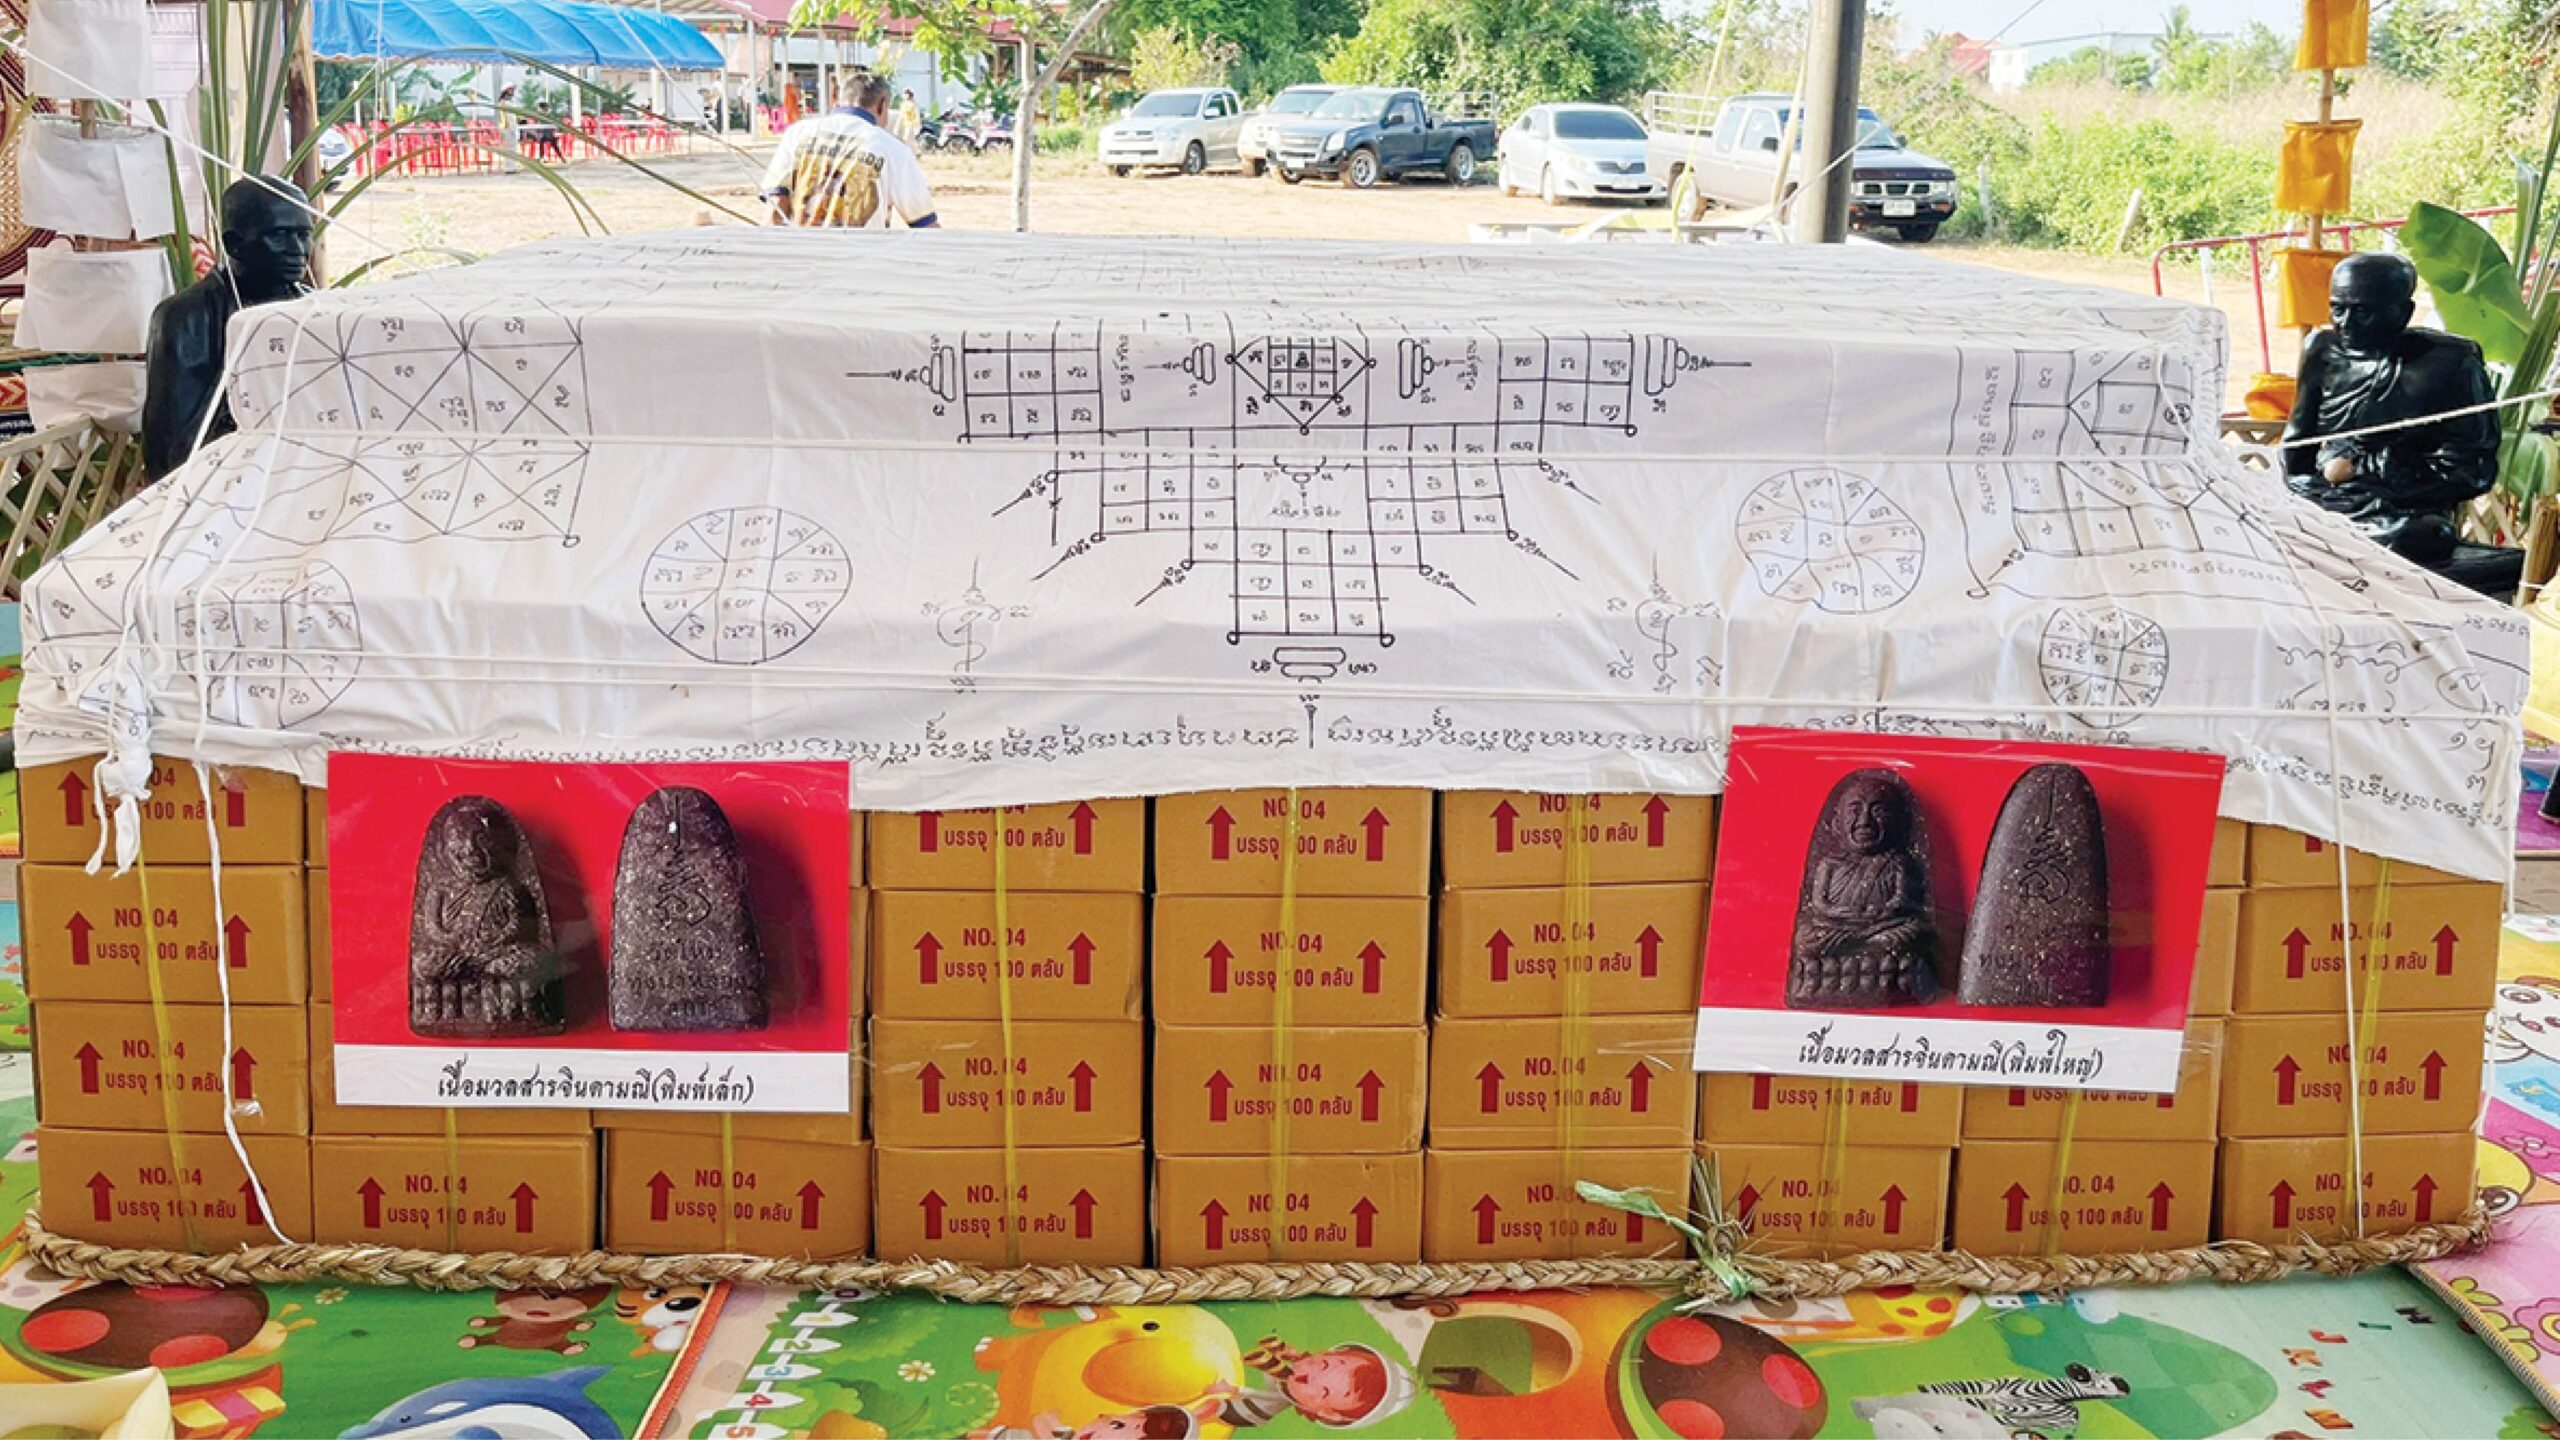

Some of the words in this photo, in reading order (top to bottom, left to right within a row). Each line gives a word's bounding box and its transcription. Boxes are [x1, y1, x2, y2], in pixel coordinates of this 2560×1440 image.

[145, 803, 175, 820] 100
[1301, 800, 1326, 819] 04
[945, 830, 988, 852] บรรจุ
[996, 829, 1025, 847] 00
[1237, 837, 1280, 860] บรรจุ
[1298, 838, 1317, 855] 00
[1521, 829, 1563, 849] บรรจุ
[154, 909, 178, 927] 04
[963, 929, 997, 947] NO.
[1298, 933, 1323, 952] 04
[1535, 923, 1566, 943] NO.
[159, 942, 178, 960] 00
[945, 961, 987, 983] บรรจุ
[1516, 956, 1557, 979] บรรจุ
[1564, 955, 1593, 972] 100
[1235, 968, 1277, 992] บรรจุ
[1285, 968, 1314, 986] 00
[123, 1040, 155, 1059] NO.
[965, 1058, 999, 1076] NO.
[1298, 1063, 1323, 1082] 04
[1525, 1058, 1556, 1076] NO.
[106, 1072, 147, 1096] บรรจุ
[2301, 1081, 2343, 1105] บรรจุ
[947, 1091, 989, 1112] บรรจุ
[1506, 1091, 1547, 1112] บรรจุ
[1778, 1089, 1818, 1111] บรรจุ
[140, 1167, 173, 1185] NO.
[406, 1175, 439, 1193] NO.
[734, 1171, 757, 1190] 04
[2092, 1176, 2115, 1193] 04
[2363, 1172, 2374, 1190] 4
[967, 1185, 1001, 1204] NO.
[1782, 1180, 1813, 1197] NO.
[118, 1199, 160, 1222] บรรจุ
[675, 1199, 718, 1225] บรรจุ
[734, 1203, 754, 1221] 00
[1287, 1193, 1310, 1212] 04
[388, 1207, 429, 1230] บรรจุ
[1762, 1211, 1802, 1233] บรรจุ
[2077, 1208, 2105, 1225] 100
[2296, 1206, 2336, 1226] บรรจุ
[949, 1218, 991, 1239] บรรจุ
[1230, 1225, 1271, 1246] บรรจุ
[1501, 1221, 1543, 1243] บรรจุ
[1550, 1220, 1579, 1236] 100
[784, 1339, 814, 1351] 2
[764, 1366, 793, 1377] 3
[745, 1393, 774, 1408] 4
